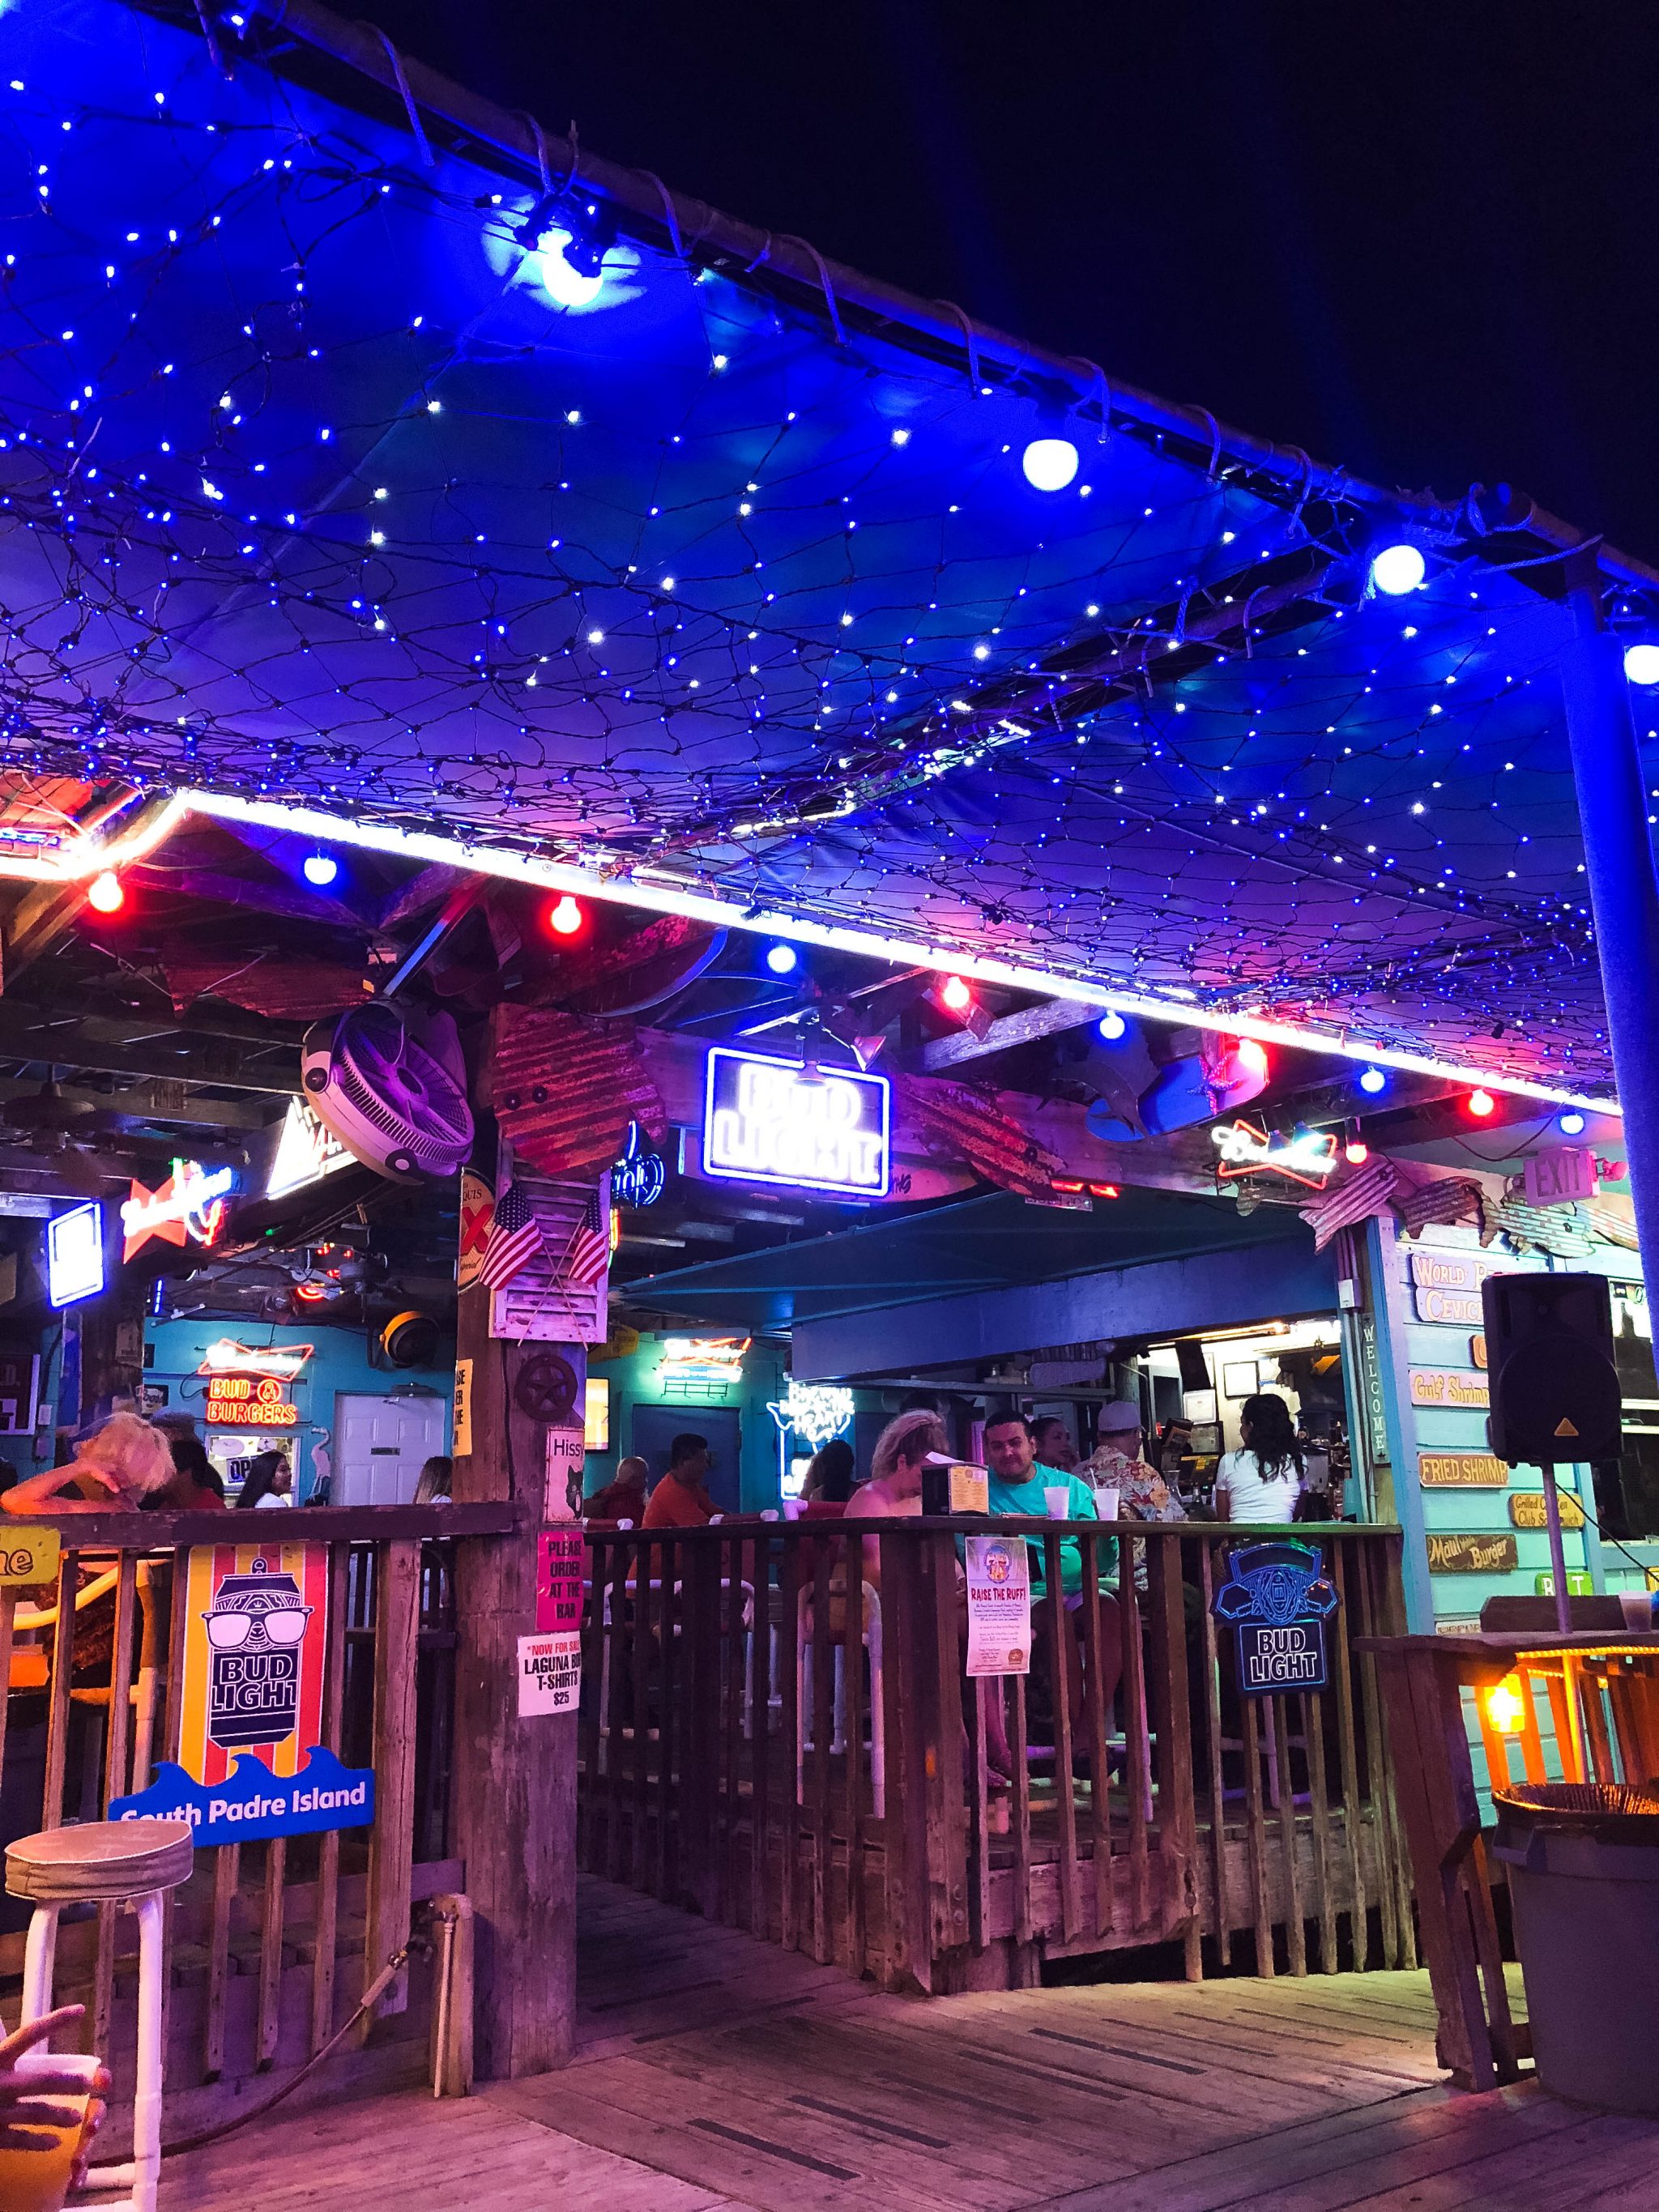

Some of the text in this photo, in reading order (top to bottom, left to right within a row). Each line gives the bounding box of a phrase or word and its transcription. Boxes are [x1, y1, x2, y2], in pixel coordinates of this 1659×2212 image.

[740, 1063, 861, 1129] BUD
[713, 1110, 882, 1183] LIGHT
[1535, 1153, 1580, 1197] EXIT
[462, 1188, 483, 1202] QUIS
[1414, 1255, 1465, 1287] WORLD
[209, 1378, 250, 1400] BUD
[1363, 1326, 1384, 1450] WELCOME
[1414, 1375, 1445, 1400] Gulf
[207, 1402, 298, 1425] BURGERS
[230, 1460, 251, 1481] OP
[1421, 1458, 1508, 1483] FRIED SHRIMP
[1515, 1495, 1538, 1510] Grilled
[1518, 1510, 1536, 1525] Club
[1468, 1539, 1508, 1569] Burger
[549, 1581, 580, 1599] AT THE
[971, 1587, 1026, 1602] RAISE THE RUFF!
[556, 1603, 576, 1619] BAR
[555, 1642, 568, 1653] FOR
[1256, 1627, 1306, 1656] BUD
[220, 1654, 293, 1685] BUD
[524, 1655, 569, 1675] LAGUNA
[1250, 1652, 1317, 1682] LIGHT
[536, 1670, 578, 1691] T-SHIRTS
[210, 1680, 297, 1712] LIGHT
[553, 1690, 569, 1707] $25
[208, 1795, 287, 1824] Padre
[292, 1781, 366, 1813] Island
